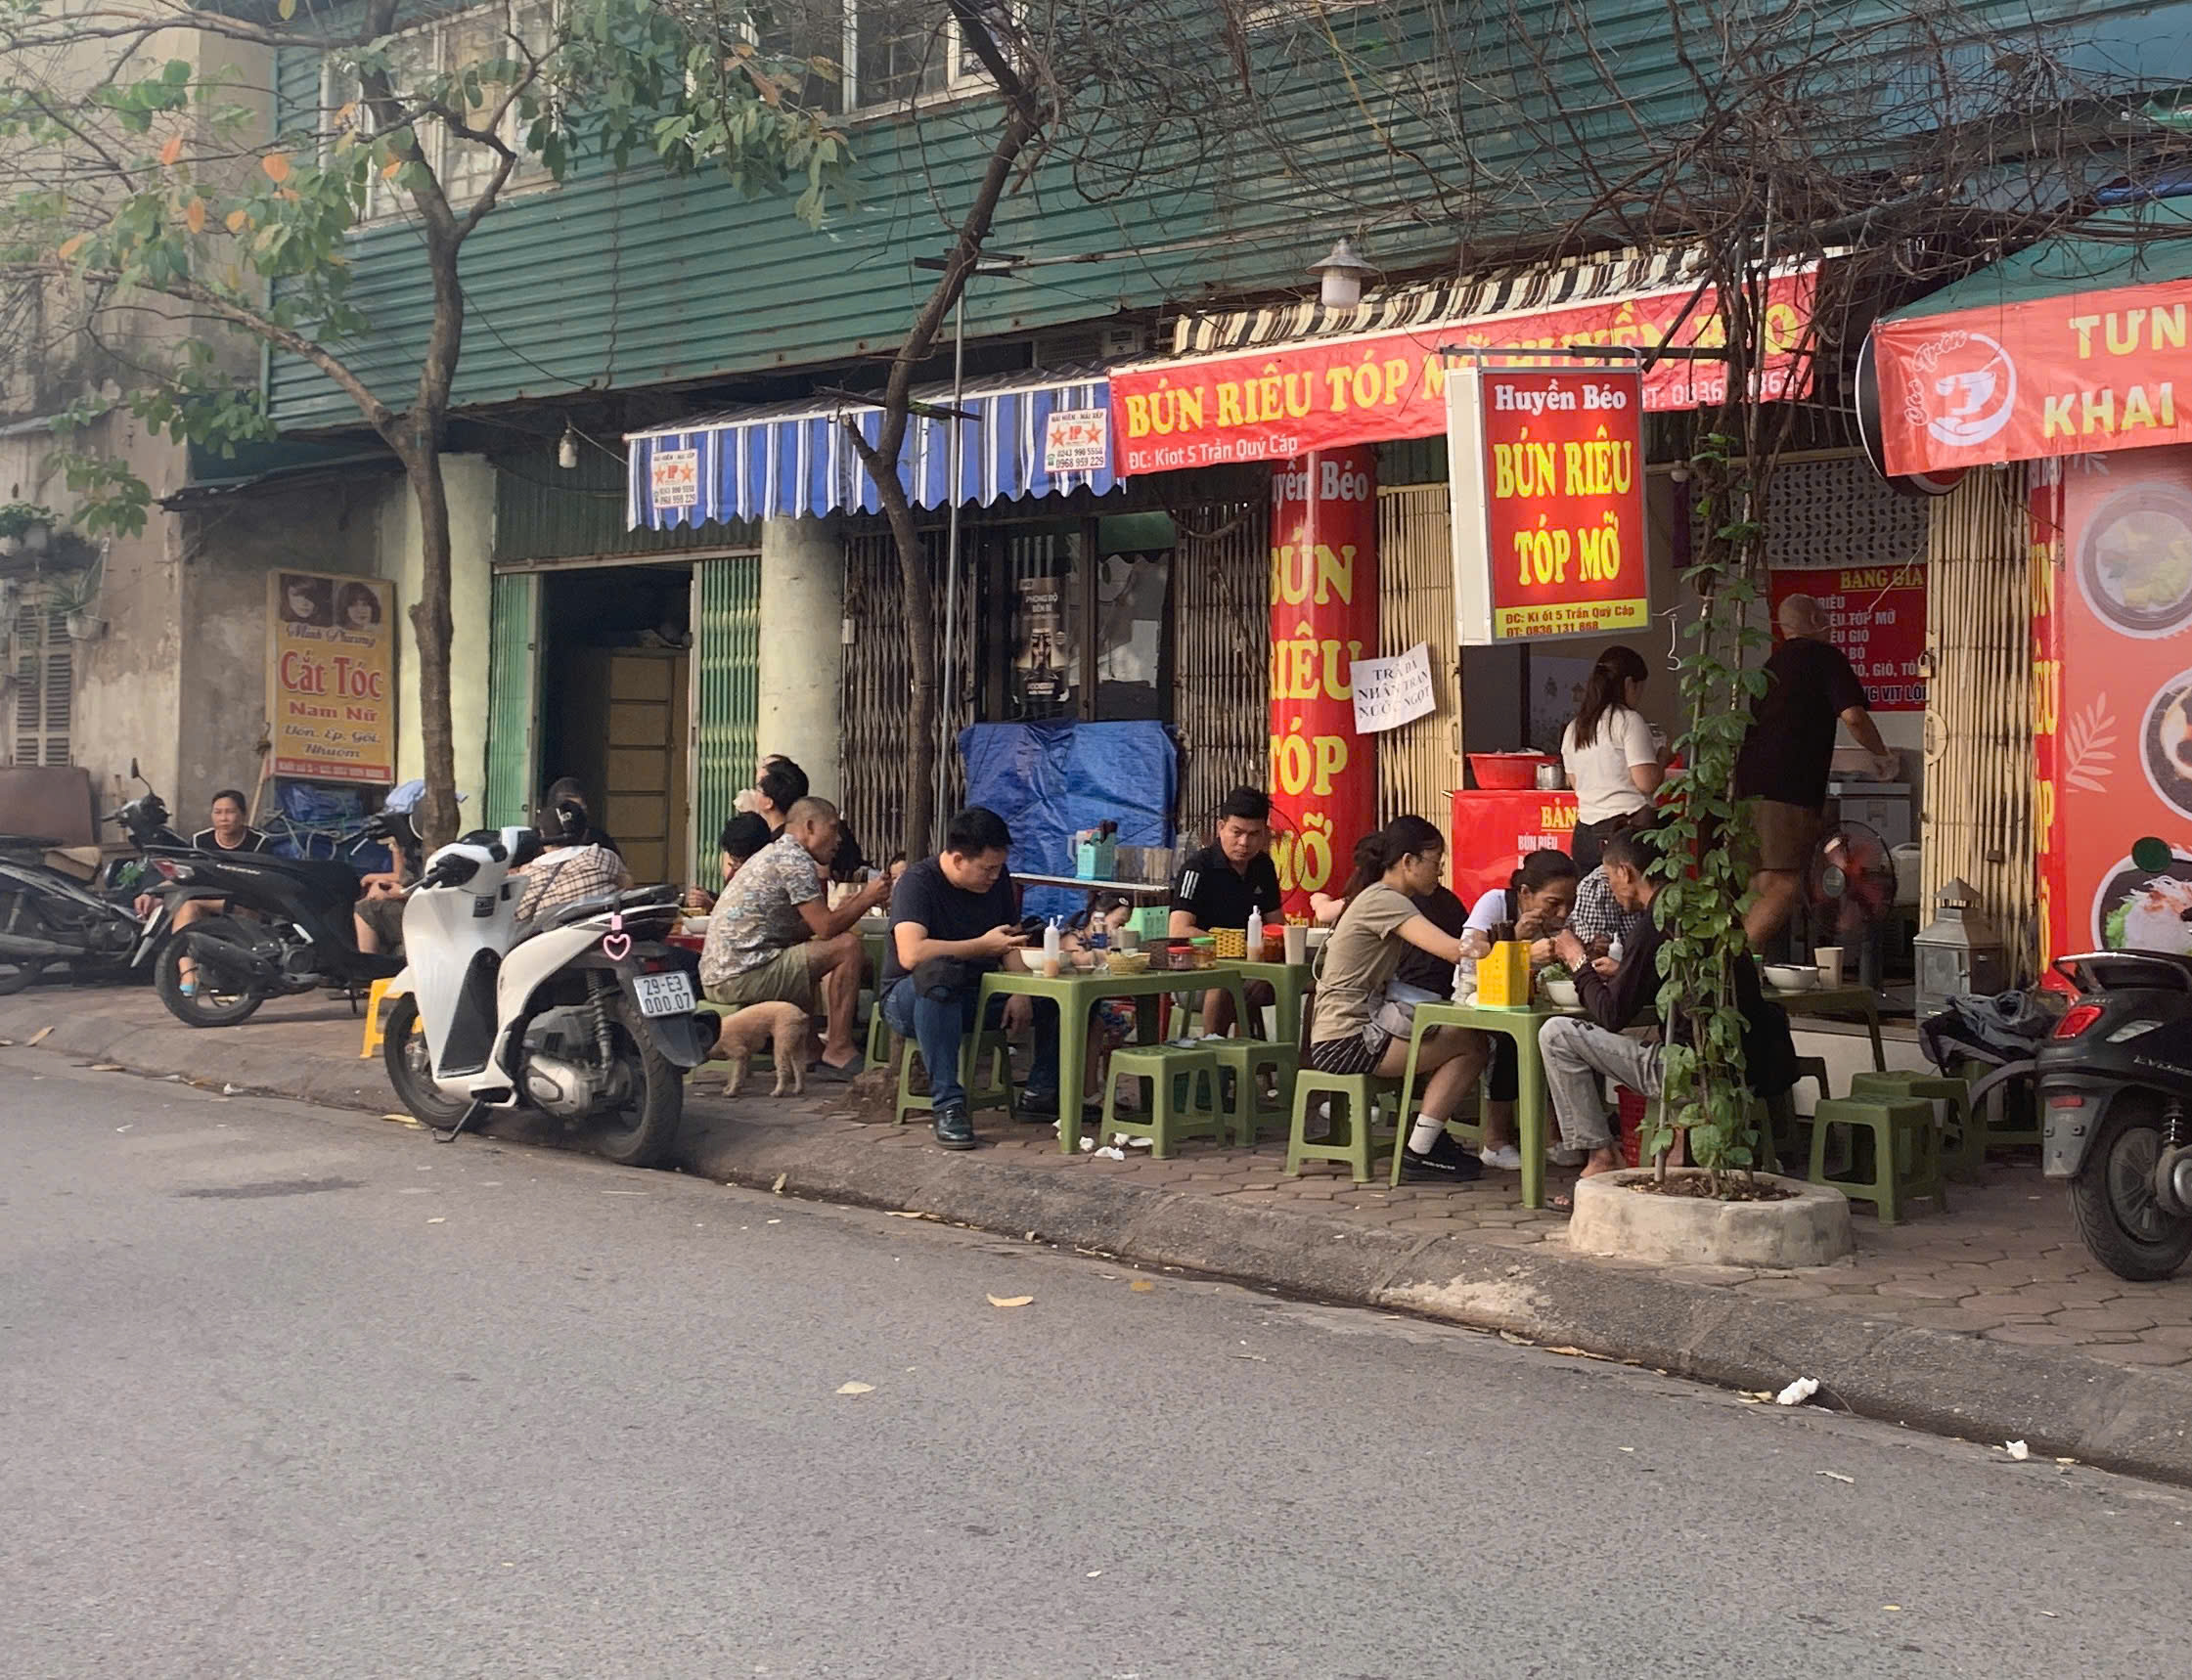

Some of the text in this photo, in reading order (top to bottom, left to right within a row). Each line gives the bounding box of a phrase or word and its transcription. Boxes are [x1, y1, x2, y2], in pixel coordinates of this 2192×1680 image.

[1125, 379, 1204, 438] BÚN
[1216, 363, 1314, 427] RIÊU
[1326, 350, 1409, 413] TÓP
[1494, 378, 1627, 416] Huyền Béo
[2044, 380, 2175, 438] KHAI
[1090, 456, 1103, 466] 229
[1129, 451, 1151, 469] ĐC:
[1154, 446, 1185, 466] Kiot
[1187, 445, 1196, 463] 5
[1236, 437, 1267, 461] Quý
[1493, 423, 1632, 498] BÚN RIÊU
[1320, 461, 1367, 501] Béo
[1514, 509, 1621, 586] TÓP MỠ
[1556, 609, 1563, 620] 5
[281, 649, 381, 698] Cắt Tóc
[290, 701, 378, 722] Nam Nữ
[1541, 797, 1577, 829] BẢN
[644, 976, 683, 995] 29-E3
